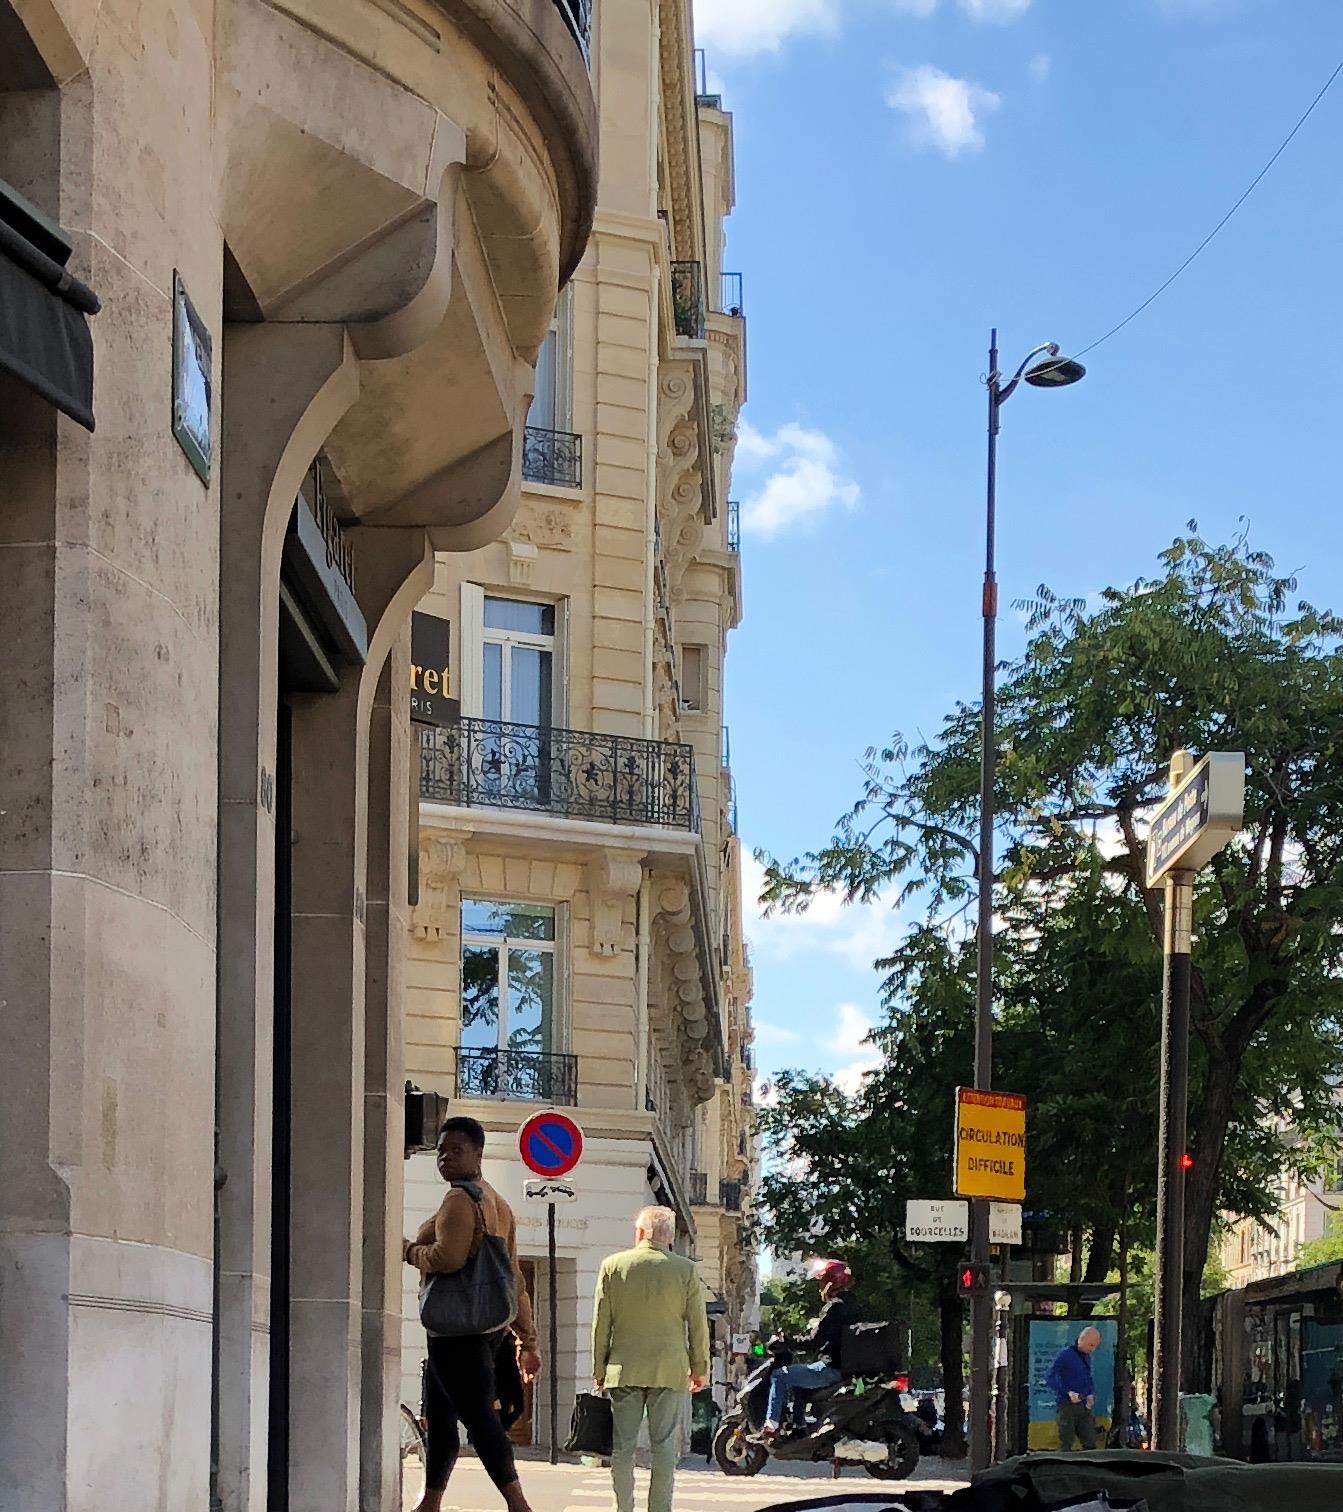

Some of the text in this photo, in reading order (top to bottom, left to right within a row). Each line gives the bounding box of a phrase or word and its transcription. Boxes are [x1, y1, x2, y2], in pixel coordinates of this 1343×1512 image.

[410, 664, 452, 699] ret
[411, 697, 433, 715] RIS
[959, 1127, 1025, 1148] CIRCULATION
[967, 1157, 1015, 1176] DIFFICILE
